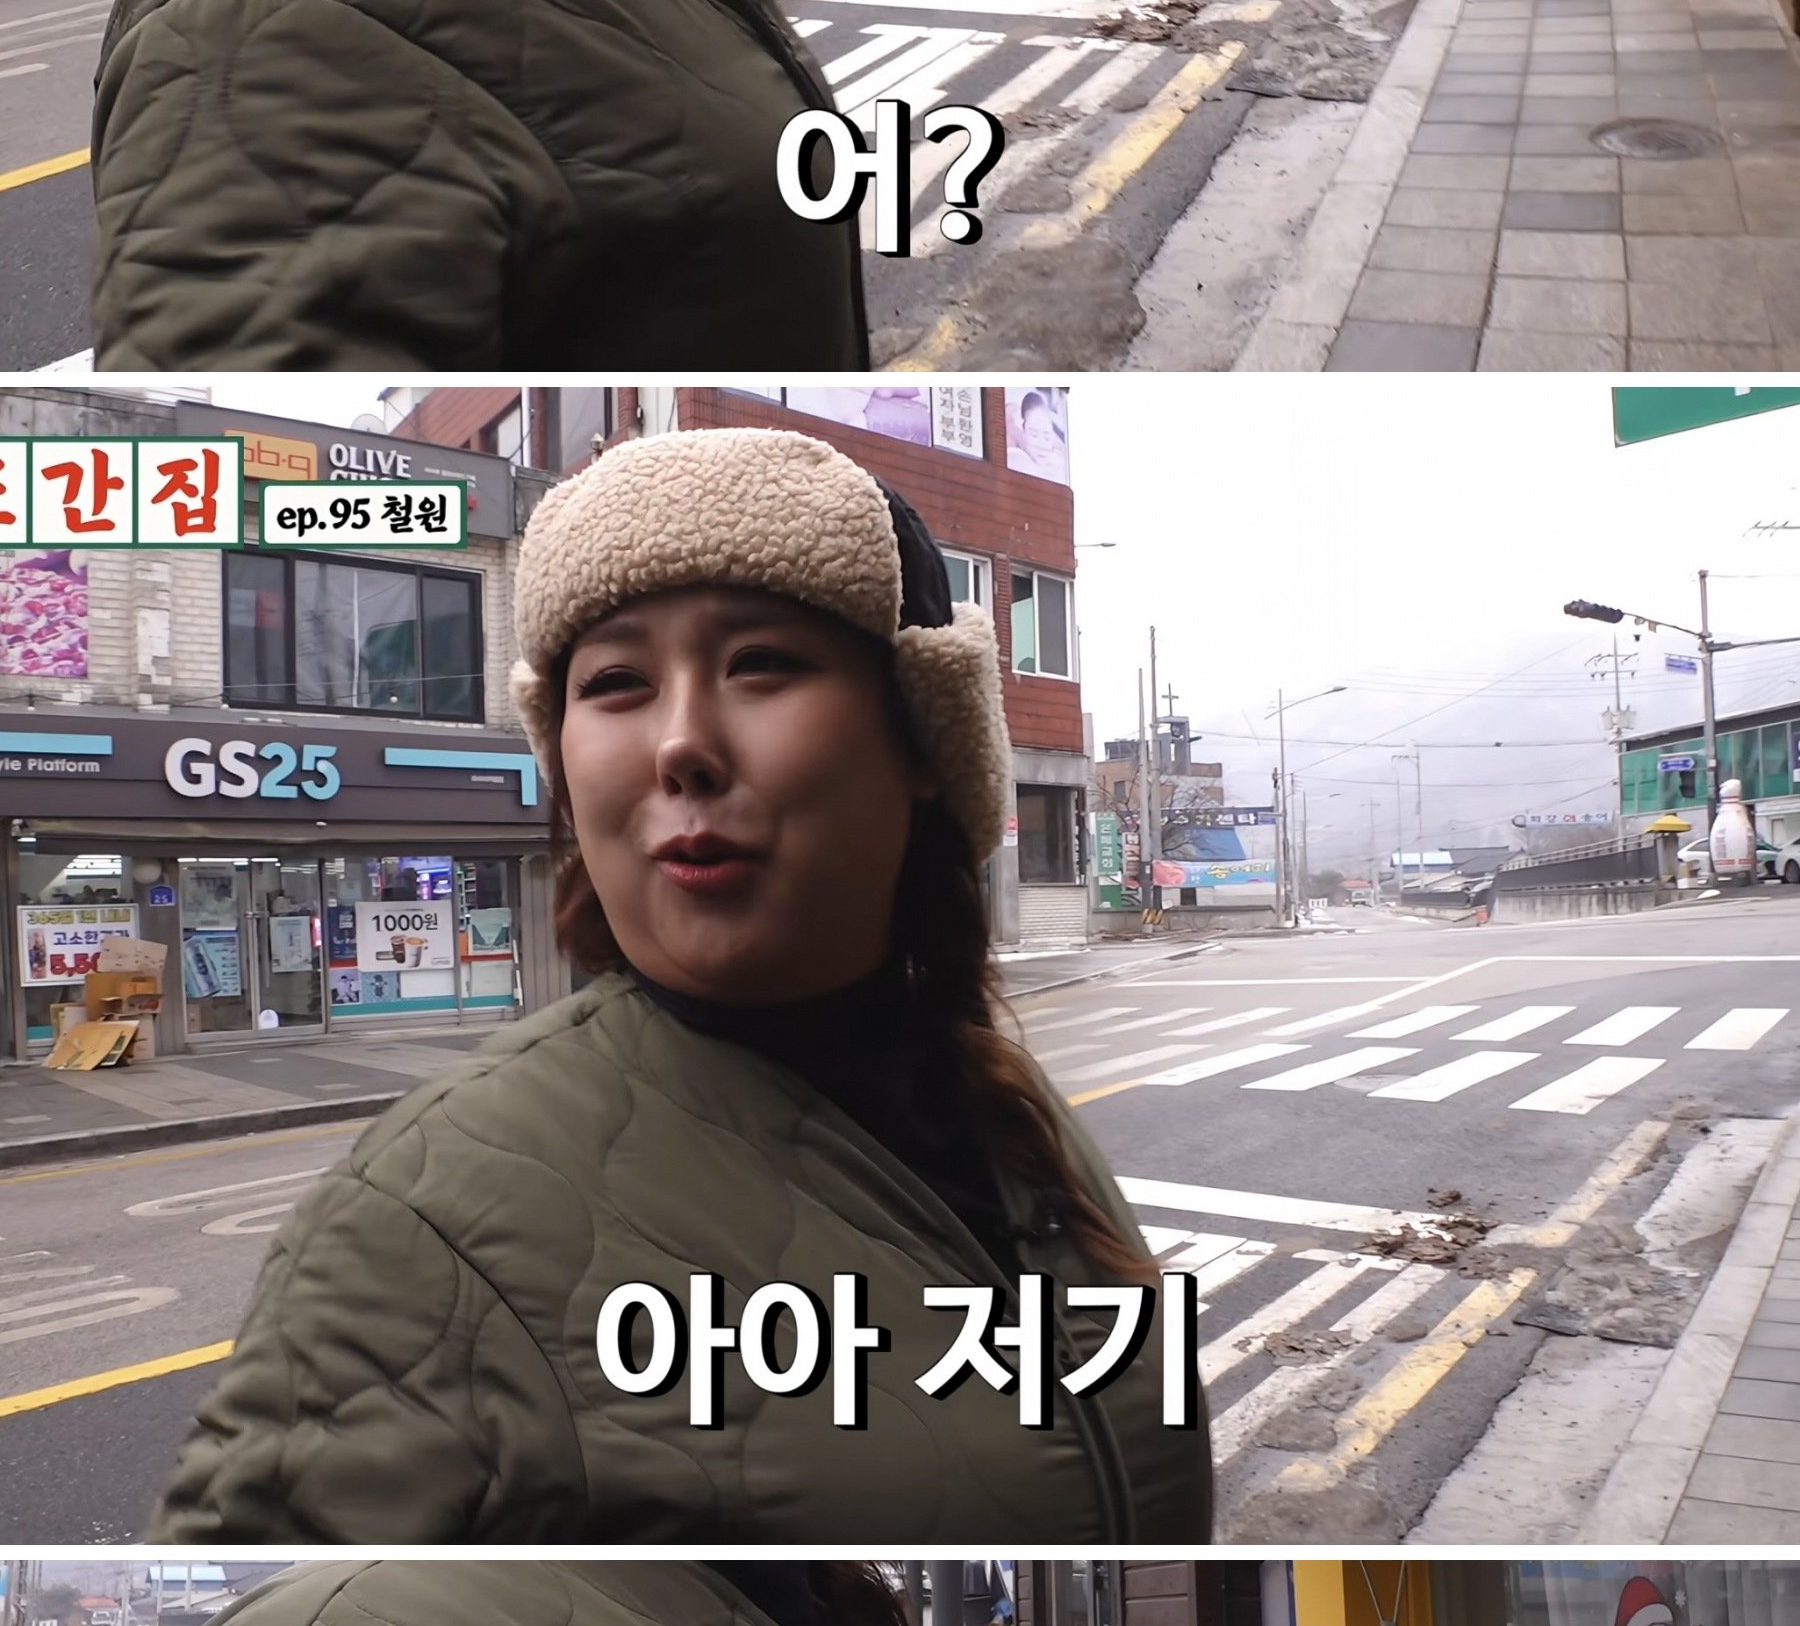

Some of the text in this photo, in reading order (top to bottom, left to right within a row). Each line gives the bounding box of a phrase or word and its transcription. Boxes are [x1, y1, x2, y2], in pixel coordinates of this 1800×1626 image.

[329, 443, 413, 479] OLIVE
[27, 758, 101, 773] Platform
[164, 737, 342, 801] GS25
[371, 912, 438, 932] 1000원
